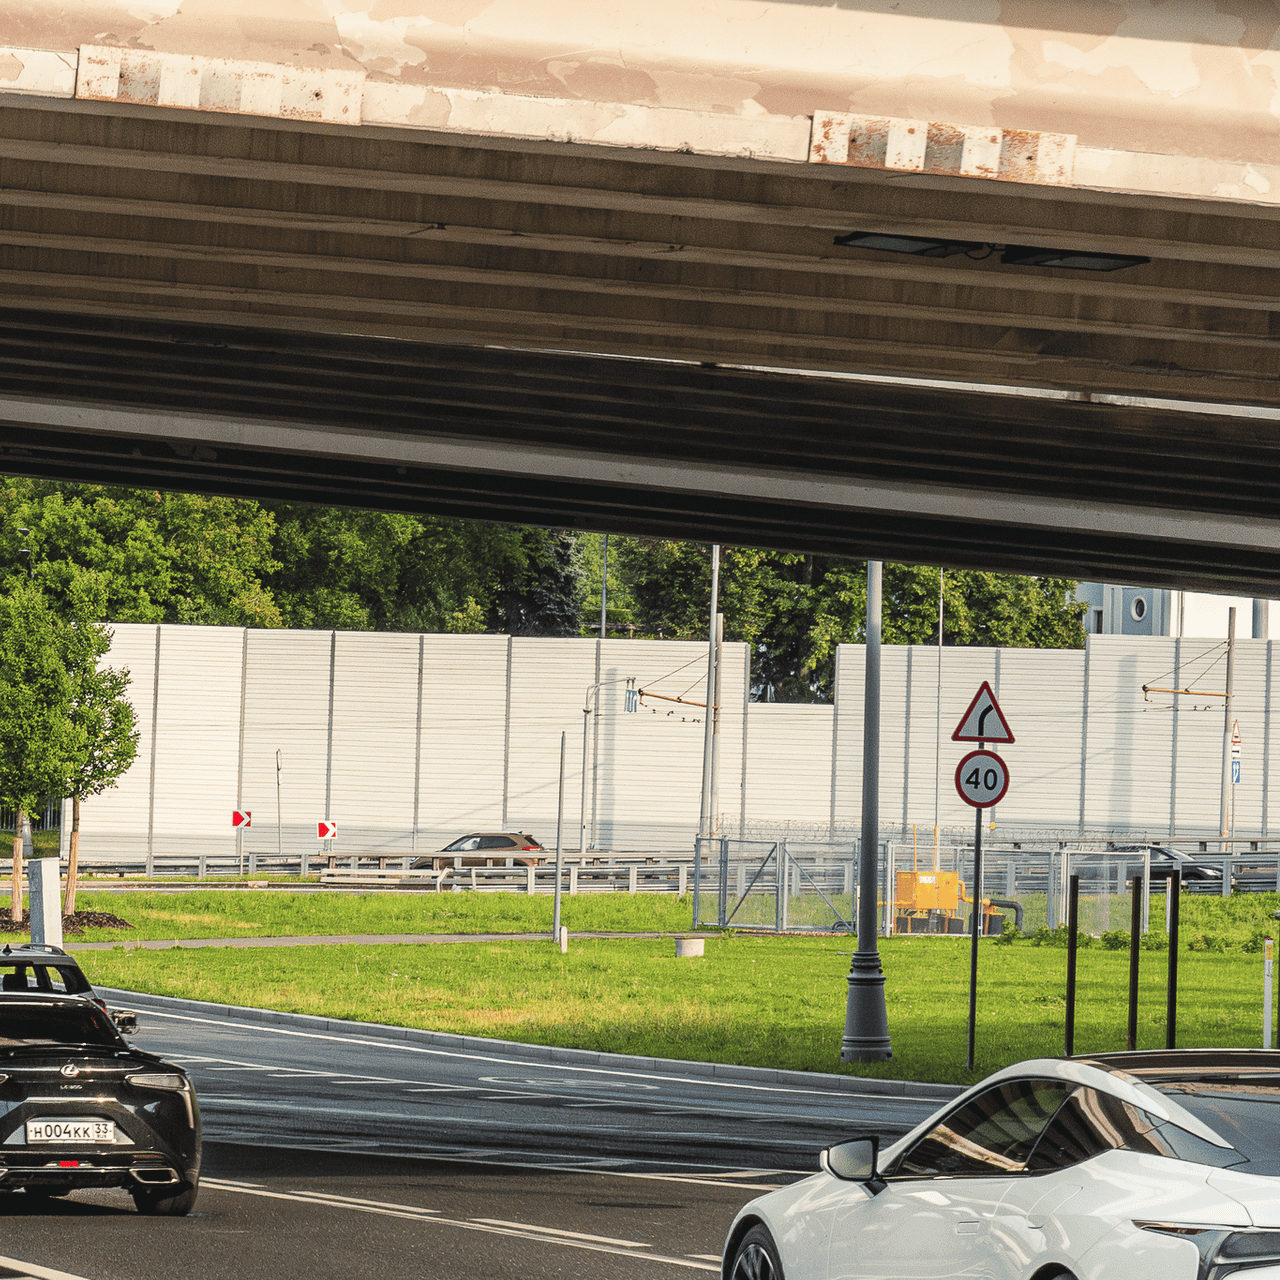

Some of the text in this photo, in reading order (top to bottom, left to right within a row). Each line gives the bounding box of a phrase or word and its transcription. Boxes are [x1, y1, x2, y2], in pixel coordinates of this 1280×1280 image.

[965, 767, 998, 791] 40
[33, 1123, 109, 1138] Н004КК 33
